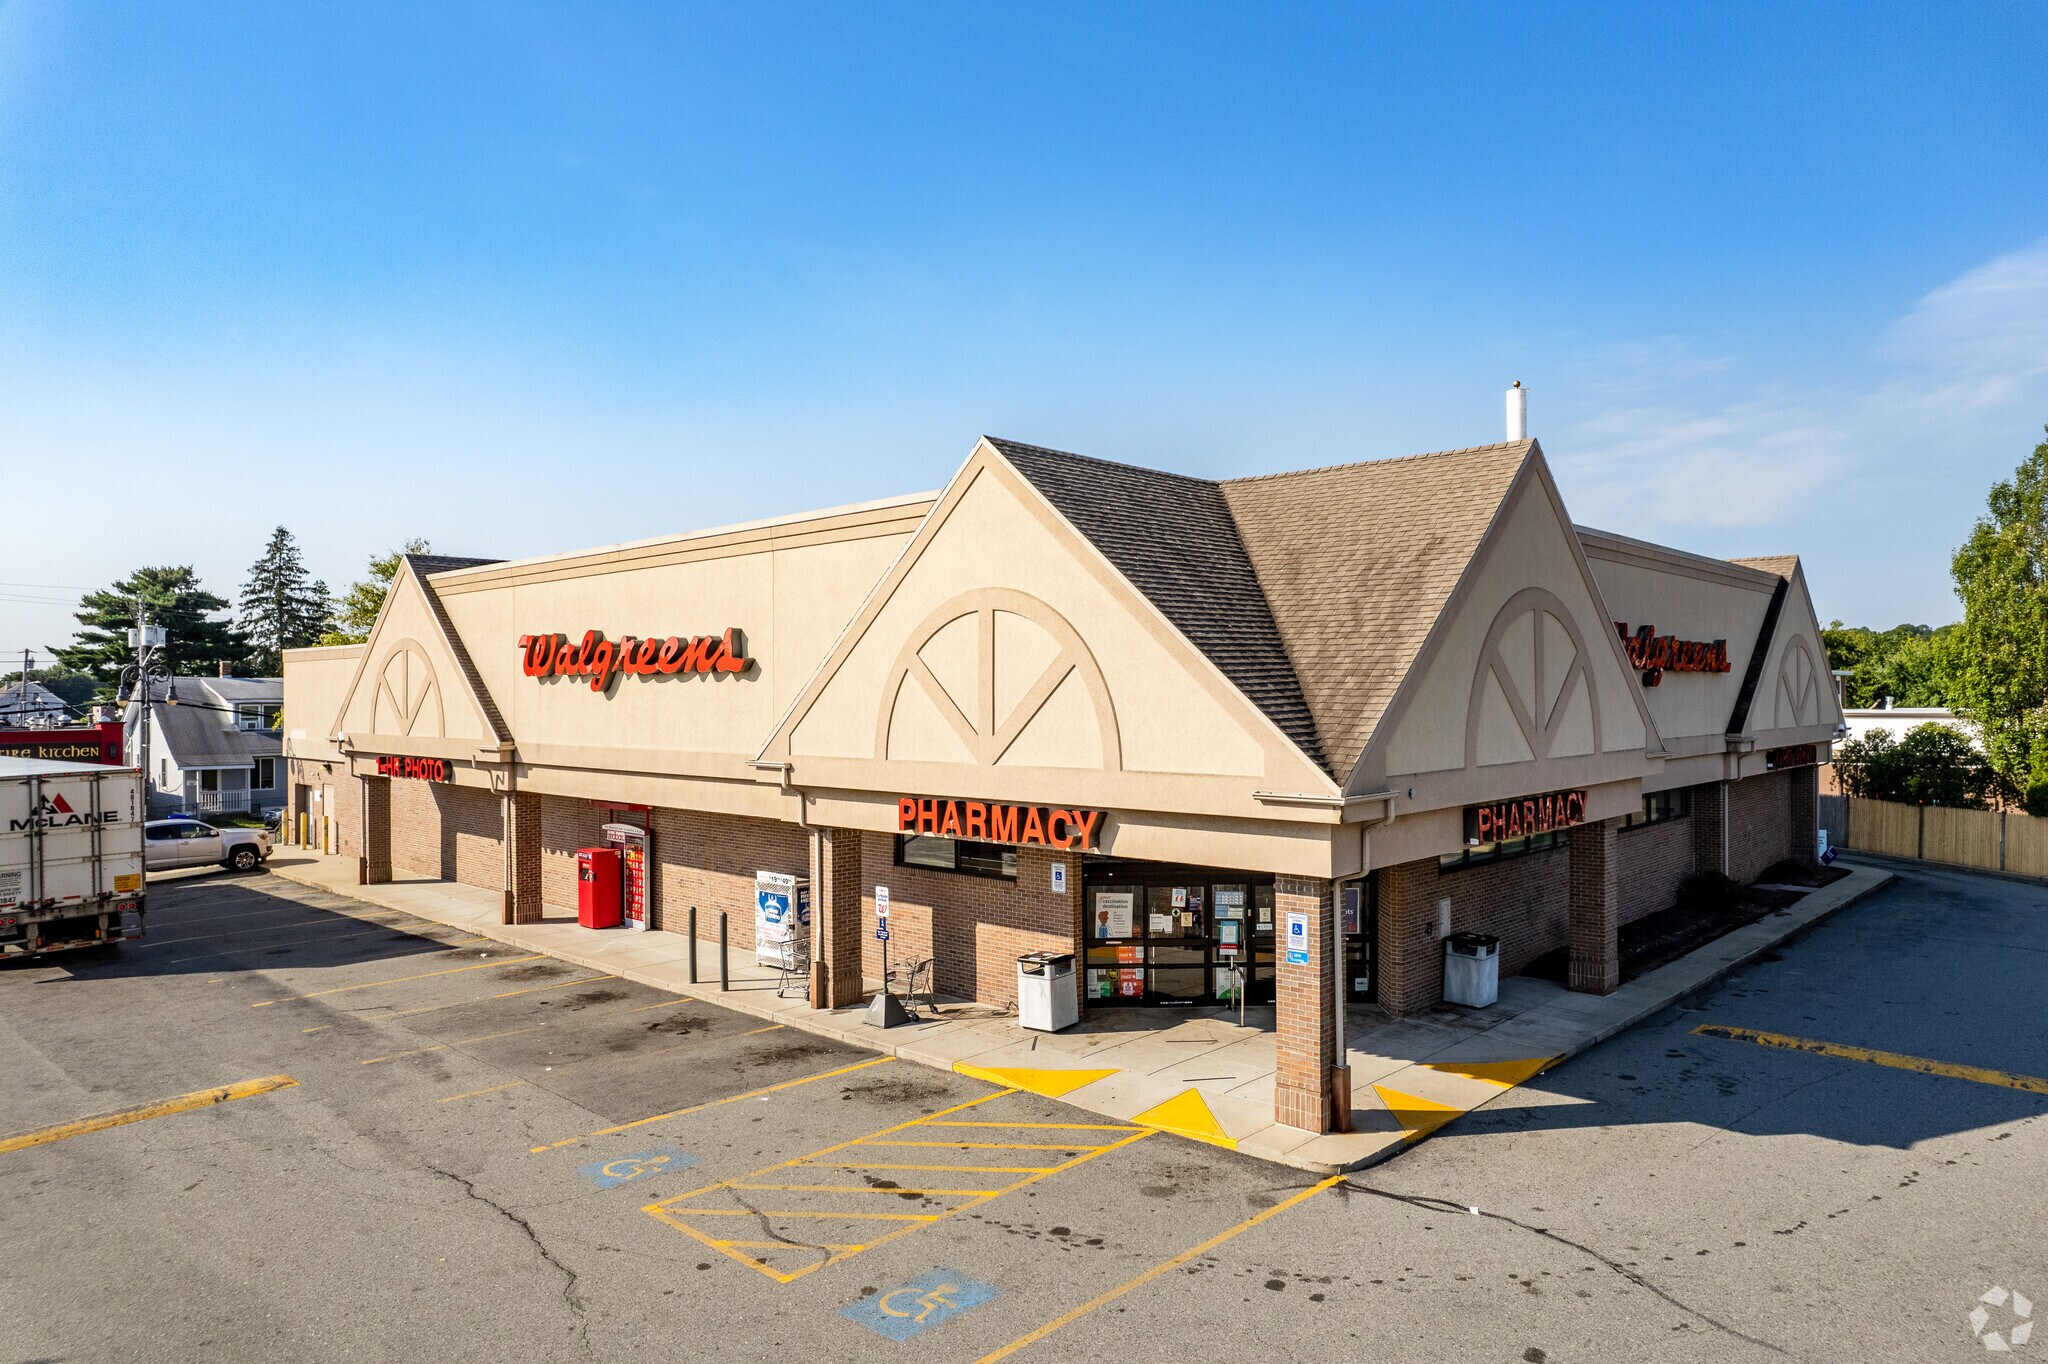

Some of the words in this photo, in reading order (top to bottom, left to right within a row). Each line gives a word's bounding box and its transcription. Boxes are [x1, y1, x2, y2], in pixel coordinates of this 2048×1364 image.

[518, 627, 745, 692] Walgreens
[405, 757, 445, 782] PHOTO
[898, 797, 1099, 850] PHARMACY
[1478, 790, 1588, 845] PHARMACY
